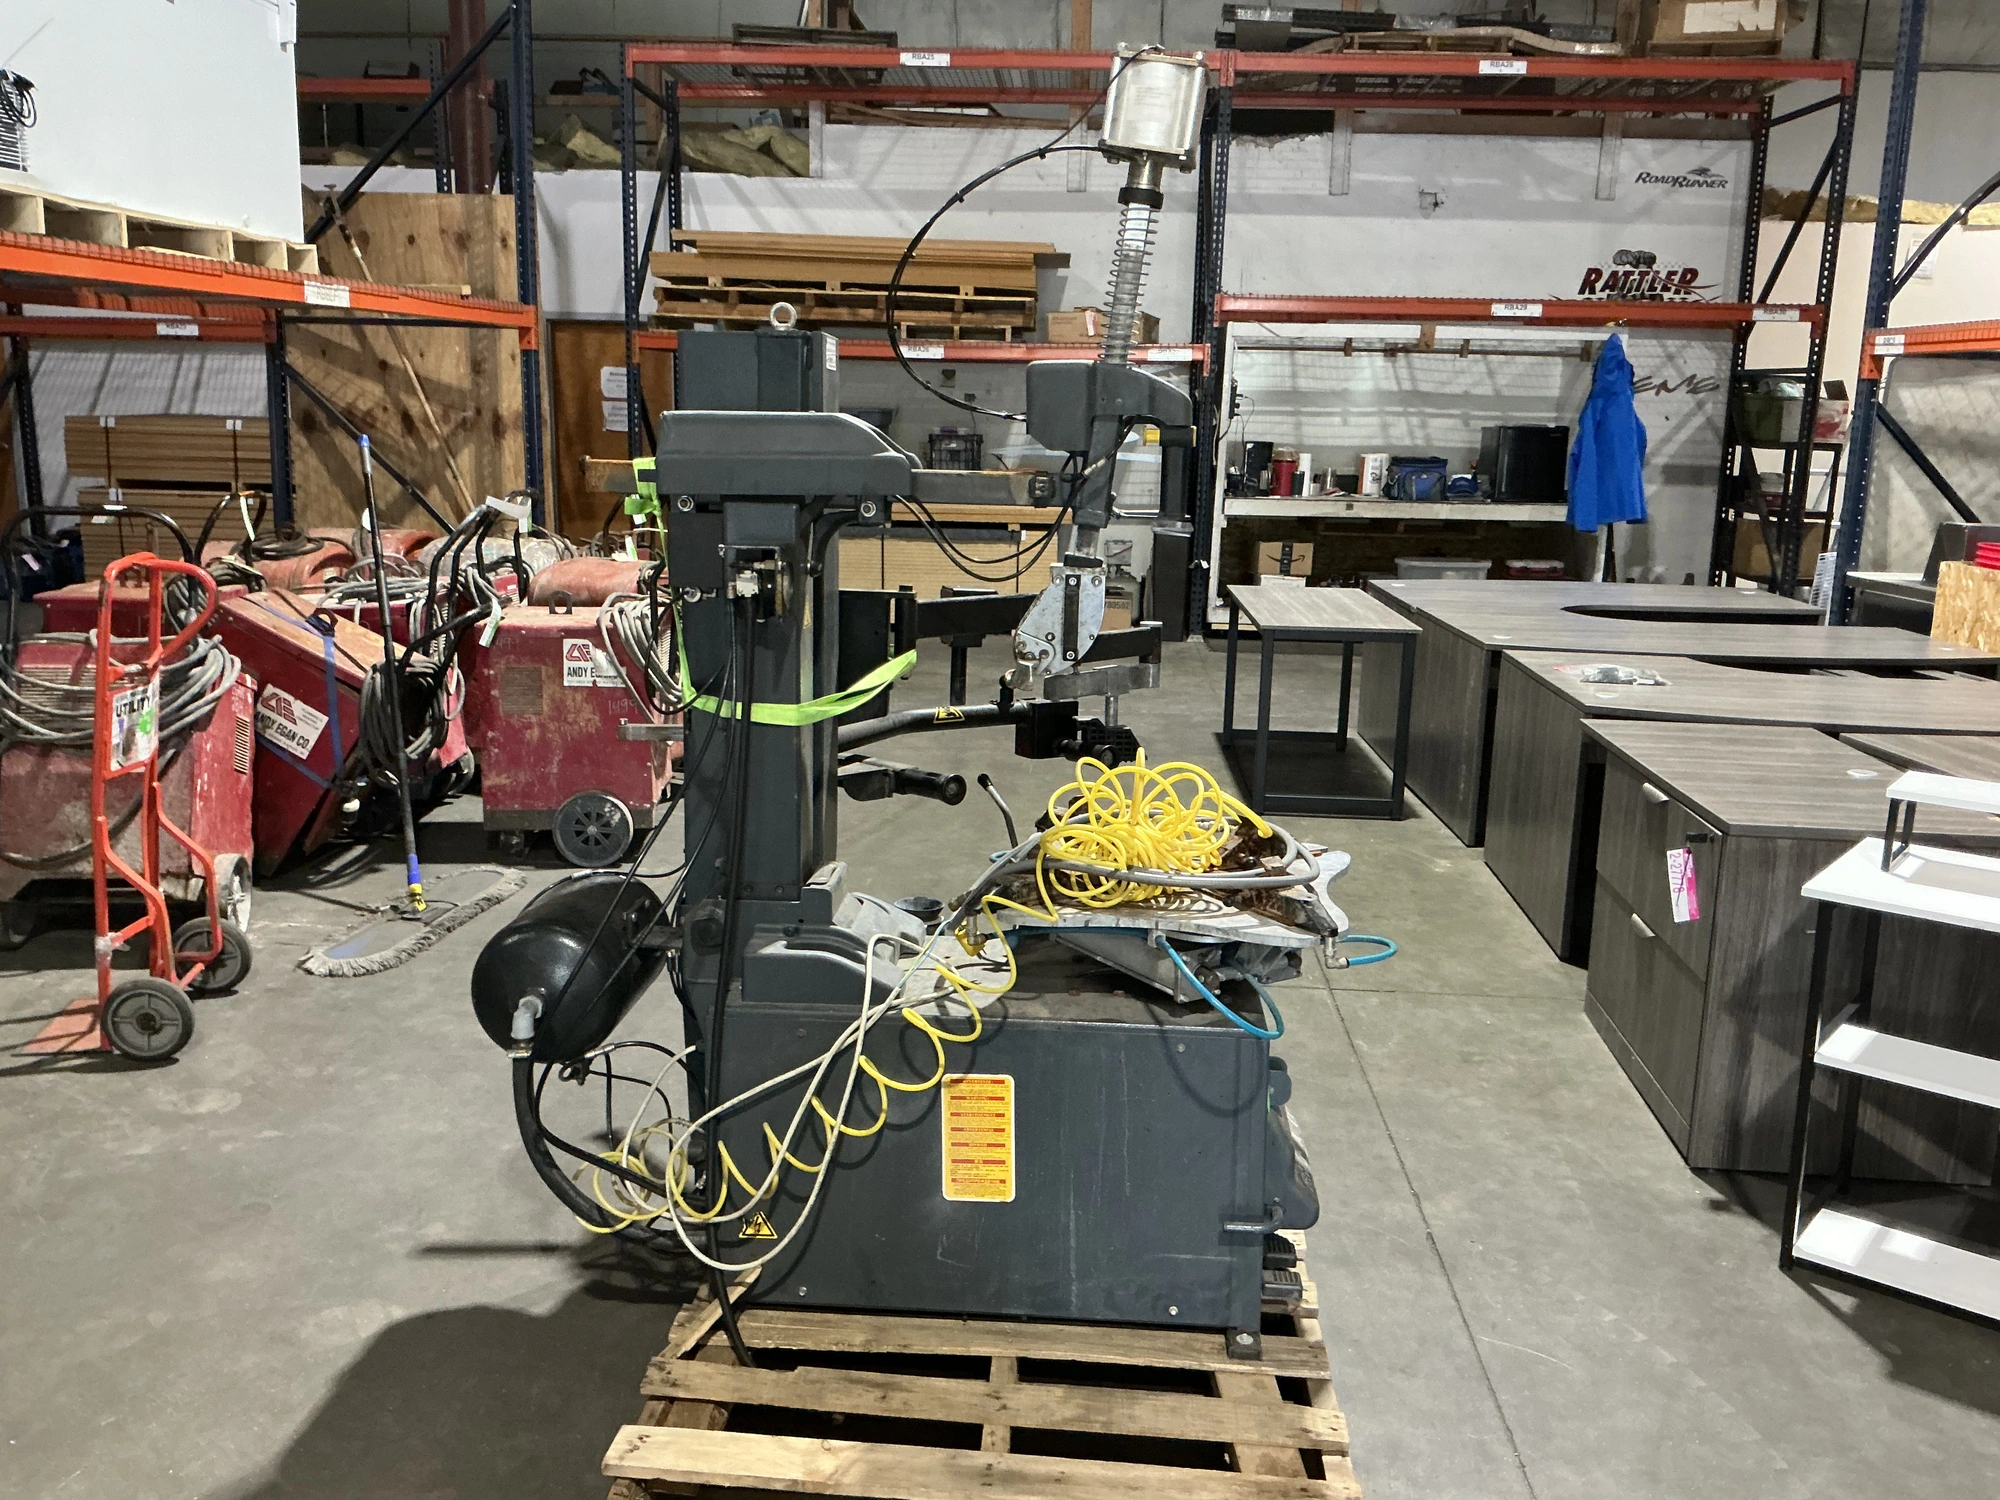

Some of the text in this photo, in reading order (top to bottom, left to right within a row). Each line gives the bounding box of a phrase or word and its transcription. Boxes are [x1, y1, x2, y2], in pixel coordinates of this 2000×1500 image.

[1577, 267, 1700, 296] RATTLER
[567, 666, 588, 678] ANDY
[115, 695, 150, 718] UTILITY
[275, 723, 298, 743] EGAN
